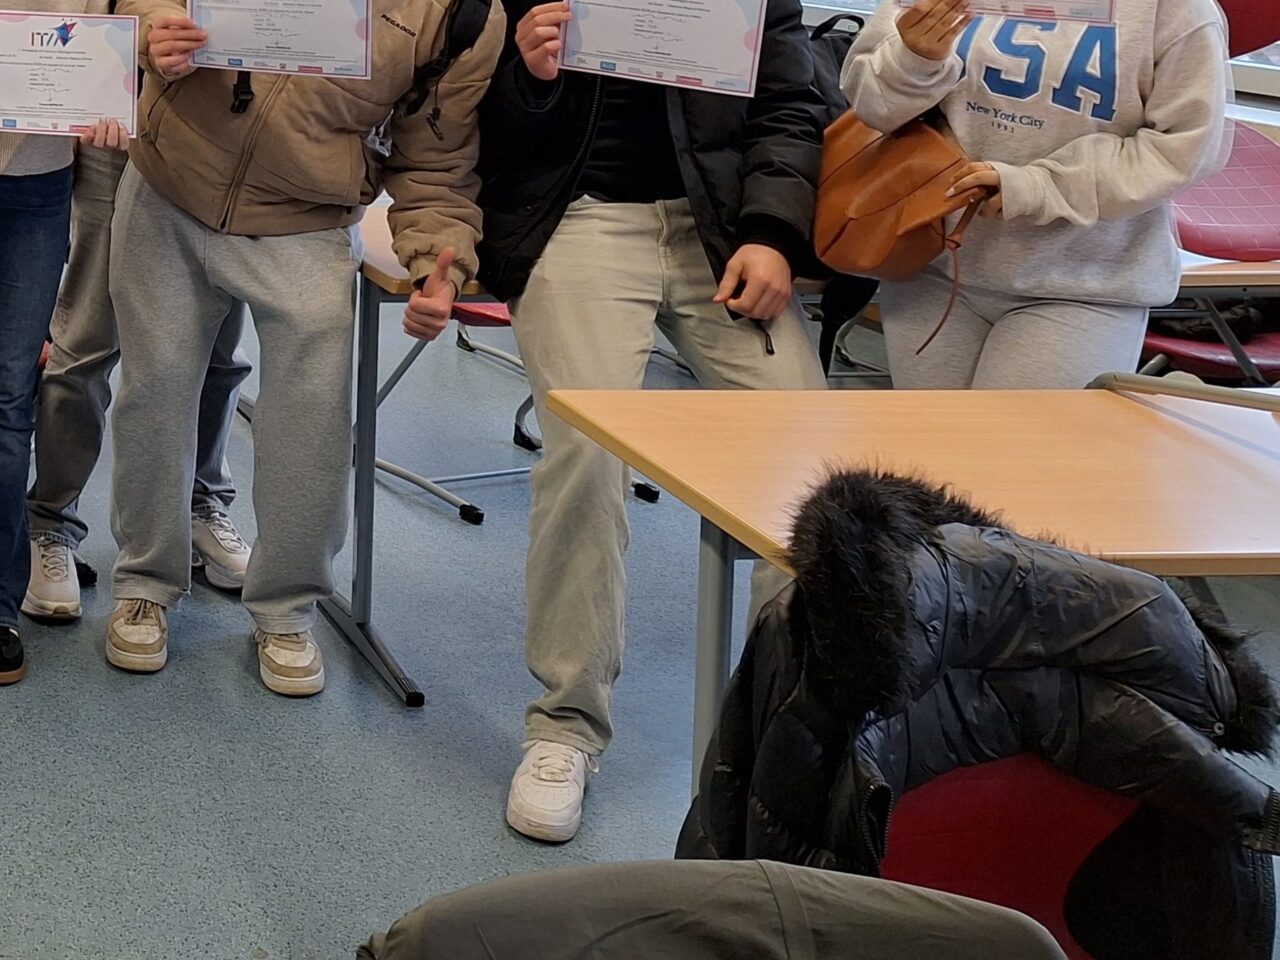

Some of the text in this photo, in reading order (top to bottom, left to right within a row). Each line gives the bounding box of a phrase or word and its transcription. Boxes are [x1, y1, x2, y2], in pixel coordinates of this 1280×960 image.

[381, 14, 416, 38] PEGADOR
[966, 101, 1045, 129] New York City
